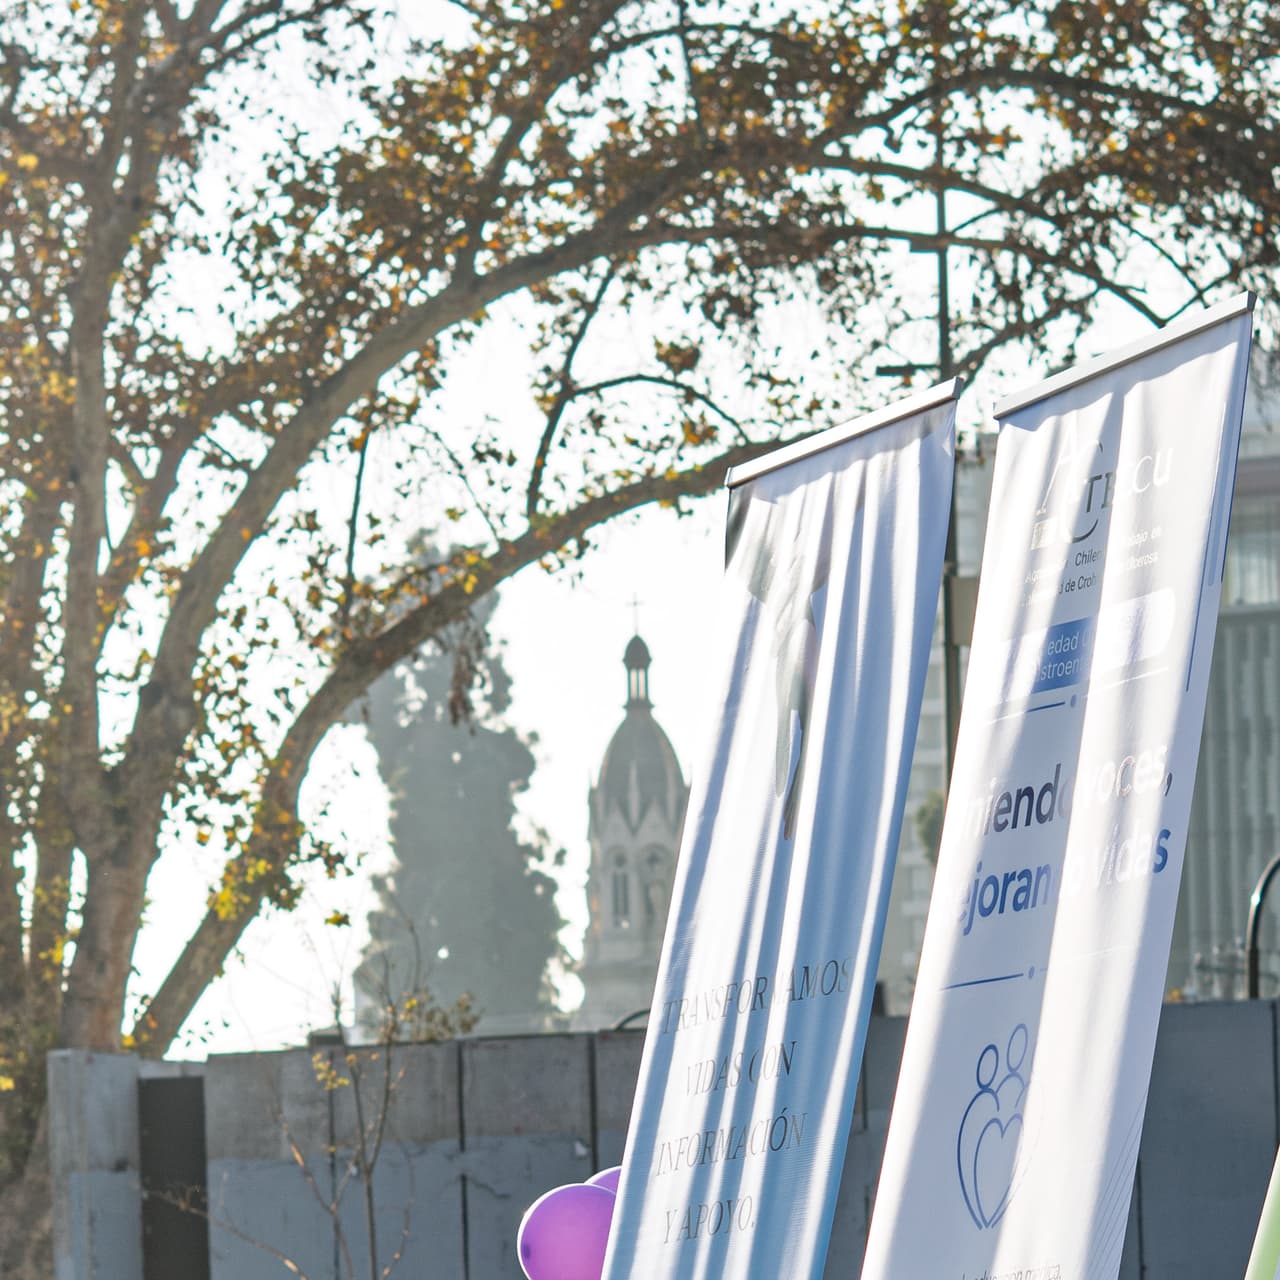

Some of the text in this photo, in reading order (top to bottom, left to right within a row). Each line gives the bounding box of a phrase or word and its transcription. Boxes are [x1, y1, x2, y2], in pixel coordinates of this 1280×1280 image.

[662, 957, 850, 1034] TRANSFORAMOS
[748, 1040, 797, 1084] CON
[656, 1106, 809, 1177] INFORMACIÓN
